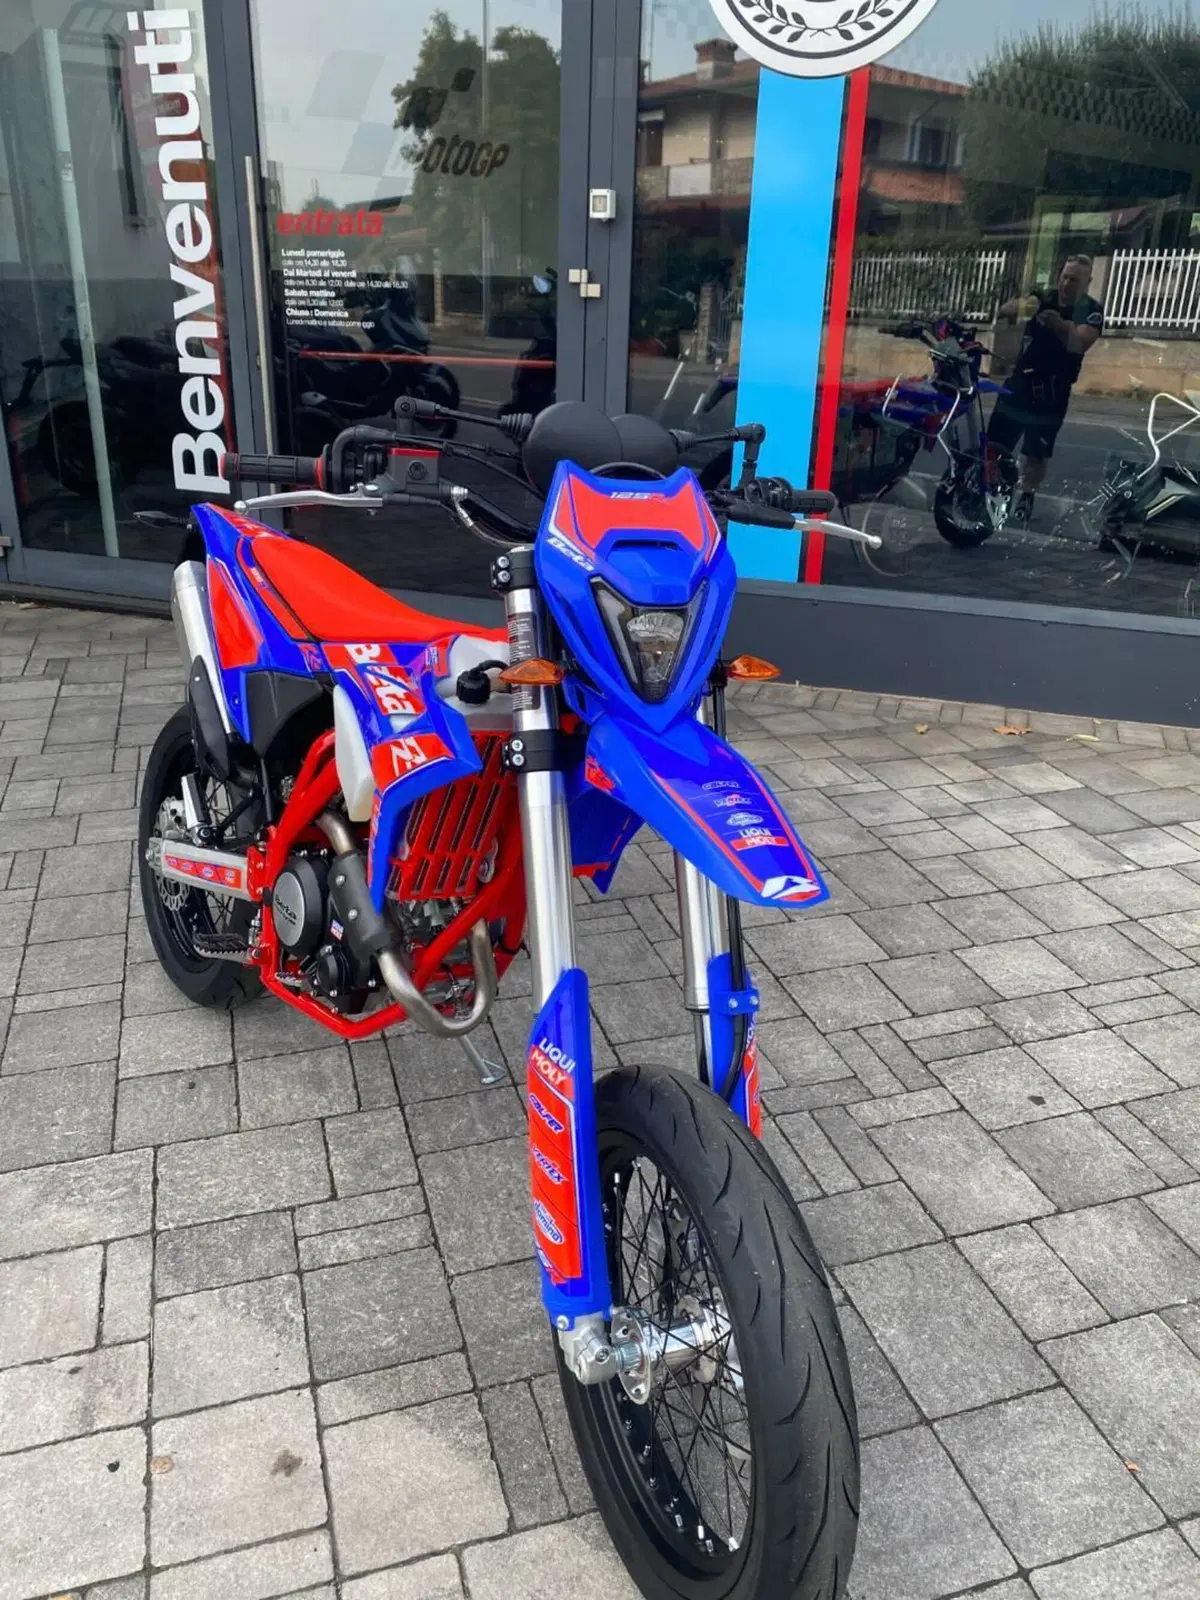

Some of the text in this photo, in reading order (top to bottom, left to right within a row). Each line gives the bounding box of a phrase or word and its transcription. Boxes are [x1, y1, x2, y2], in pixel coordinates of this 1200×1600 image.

[276, 207, 384, 237] entrata
[127, 9, 230, 494] Benvenuti
[284, 288, 336, 298] Sabato mattino
[314, 309, 349, 318] Domenica
[546, 535, 596, 572] Beta
[739, 827, 772, 838] LIQUI
[531, 1049, 568, 1085] MOLY
[538, 1037, 576, 1074] LIQUI
